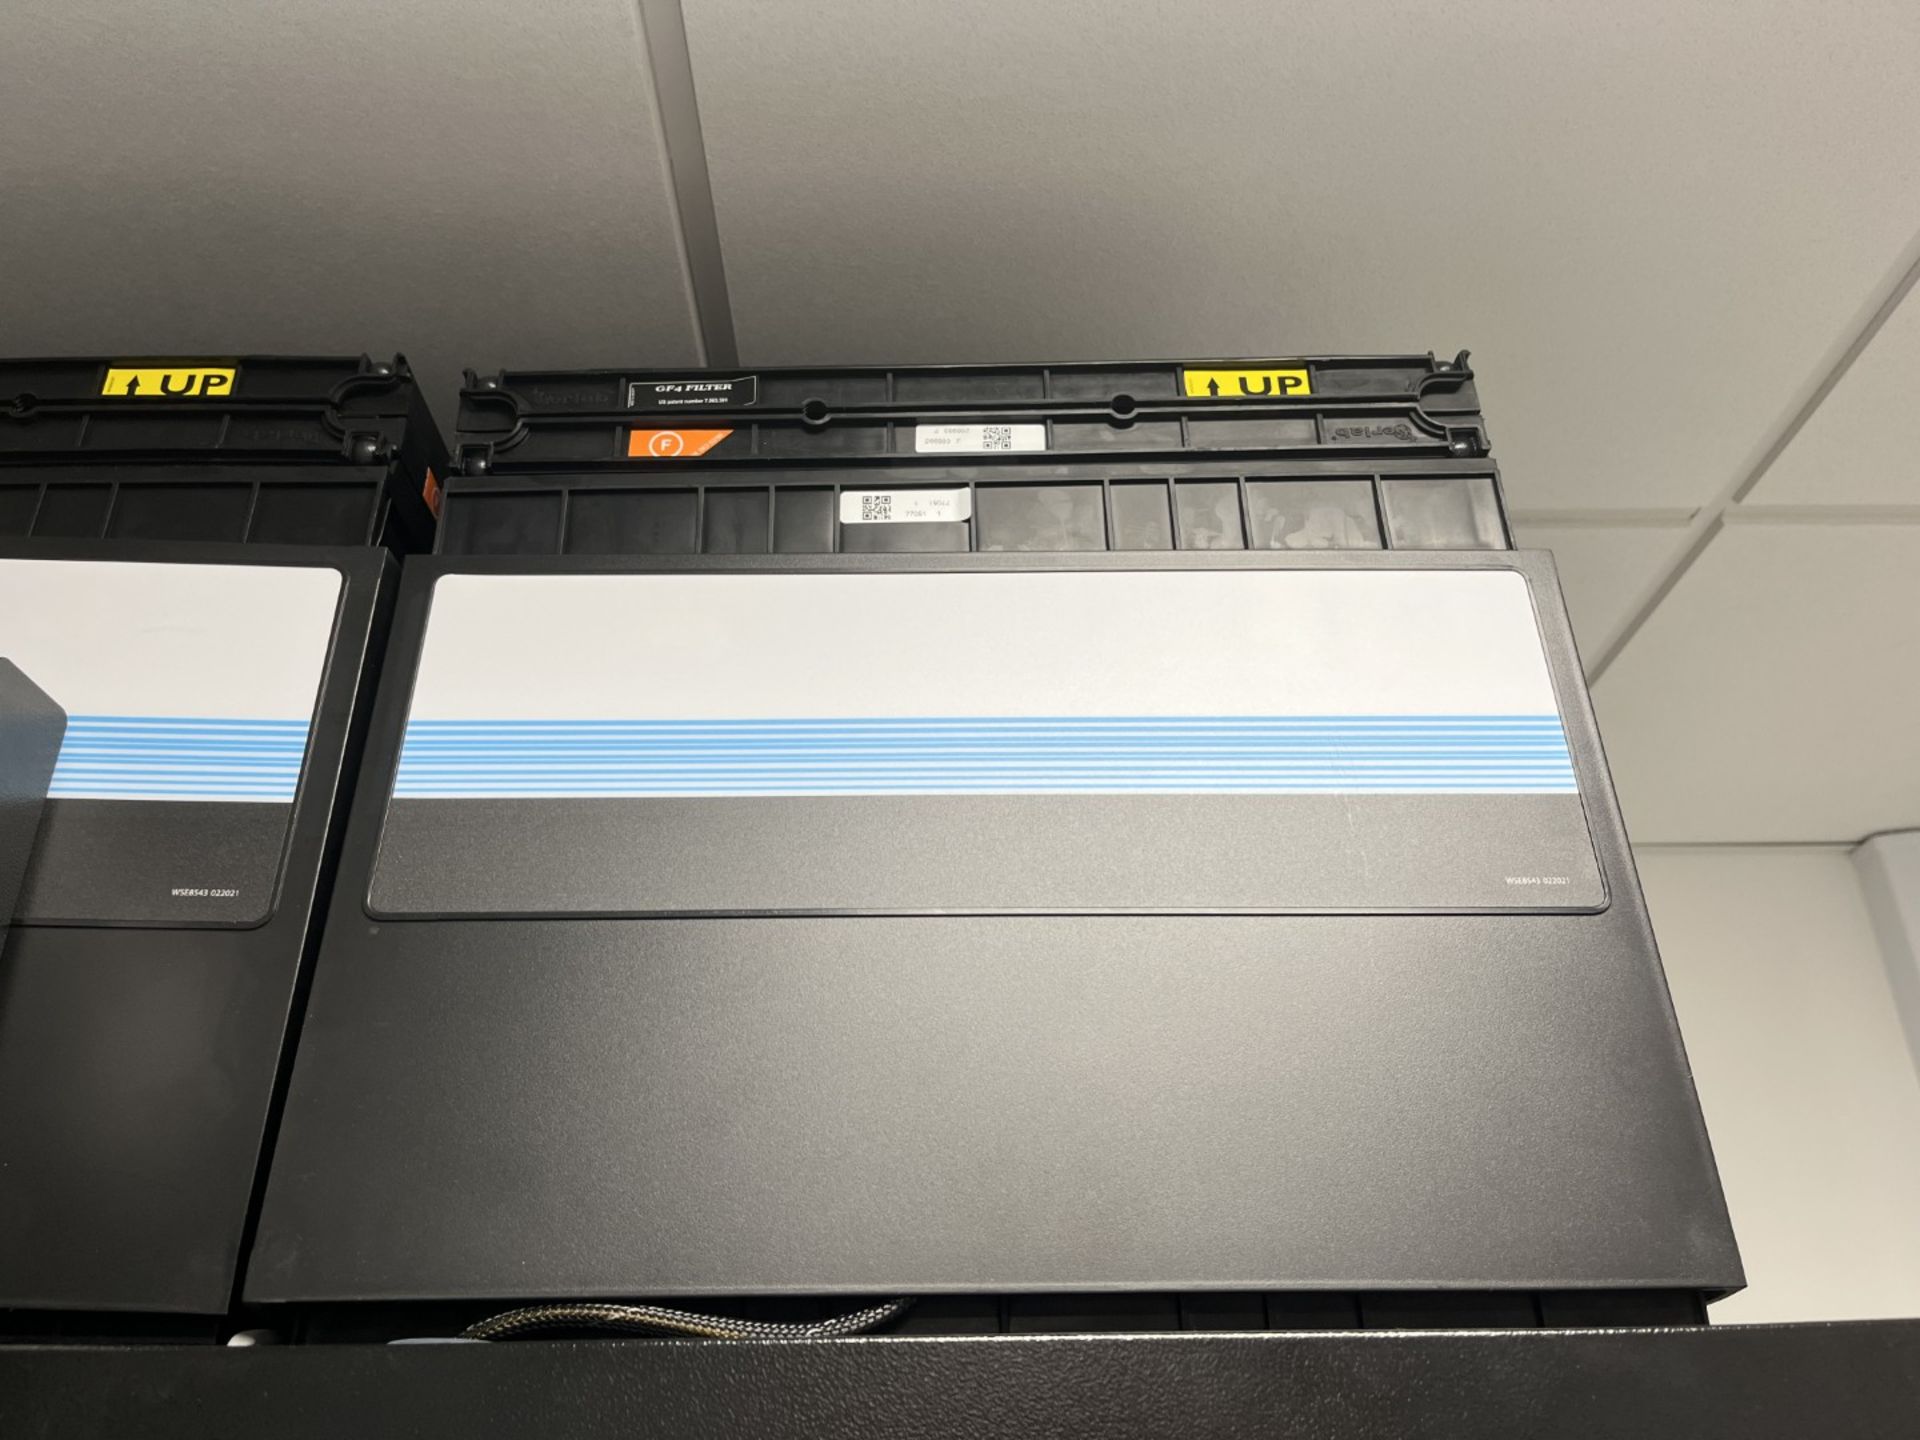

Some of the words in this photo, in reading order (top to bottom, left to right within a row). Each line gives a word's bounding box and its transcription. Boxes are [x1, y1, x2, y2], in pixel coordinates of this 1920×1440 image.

[159, 374, 229, 396] UP
[655, 385, 682, 393] GF4
[685, 383, 732, 392] FILTER
[1237, 376, 1303, 396] UP
[1504, 875, 1541, 885] WSE8543
[1542, 875, 1570, 885] 022021
[171, 888, 209, 897] WSE8543
[210, 889, 240, 897] 022021
